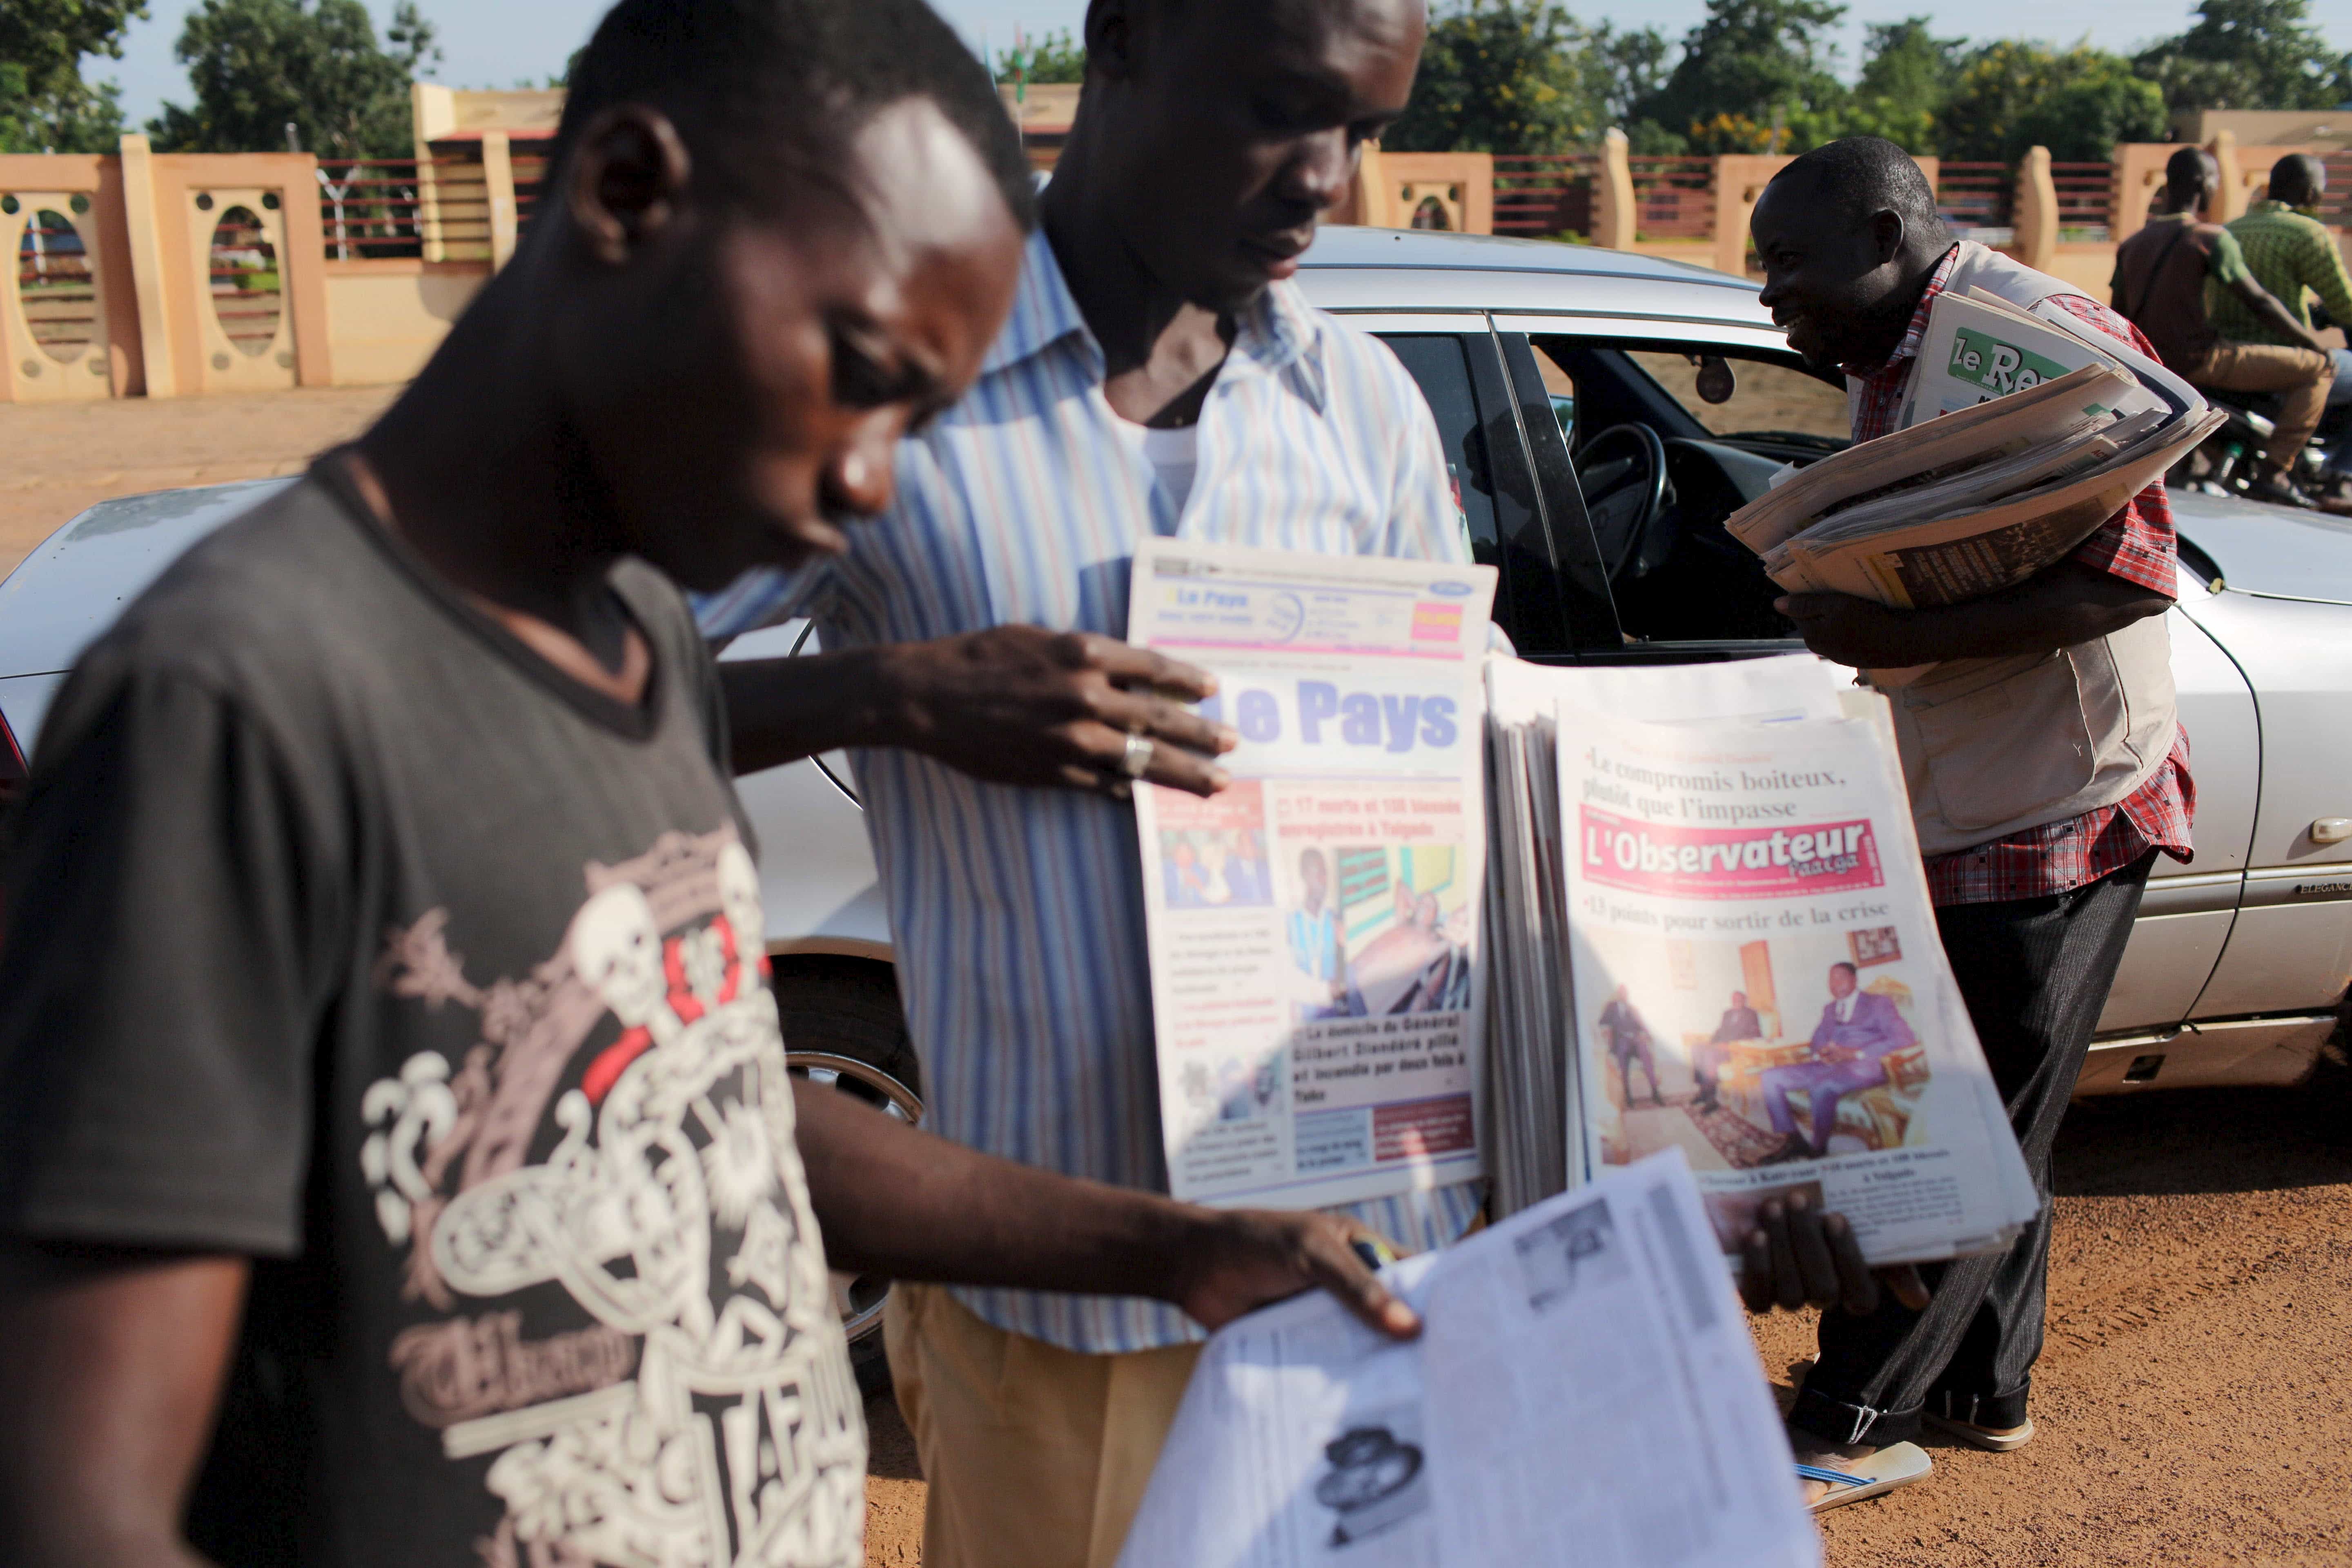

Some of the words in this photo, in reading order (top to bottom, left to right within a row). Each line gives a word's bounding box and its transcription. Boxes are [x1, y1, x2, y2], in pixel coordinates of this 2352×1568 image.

[1982, 344, 2053, 396] Re
[1297, 680, 1458, 753] Pays
[1590, 746, 1612, 774] Le
[1615, 763, 1733, 793] compromis
[1740, 770, 1846, 791] boiteux,
[1637, 796, 1675, 819] que
[1680, 796, 1797, 825] l'impasse
[1586, 824, 1864, 874] L'Observateur
[1610, 904, 1659, 926] points
[1663, 915, 1708, 931] pour
[1712, 911, 1771, 931] sortir
[1777, 909, 1804, 927] de
[1810, 906, 1831, 924] la
[1838, 901, 1890, 921] crise
